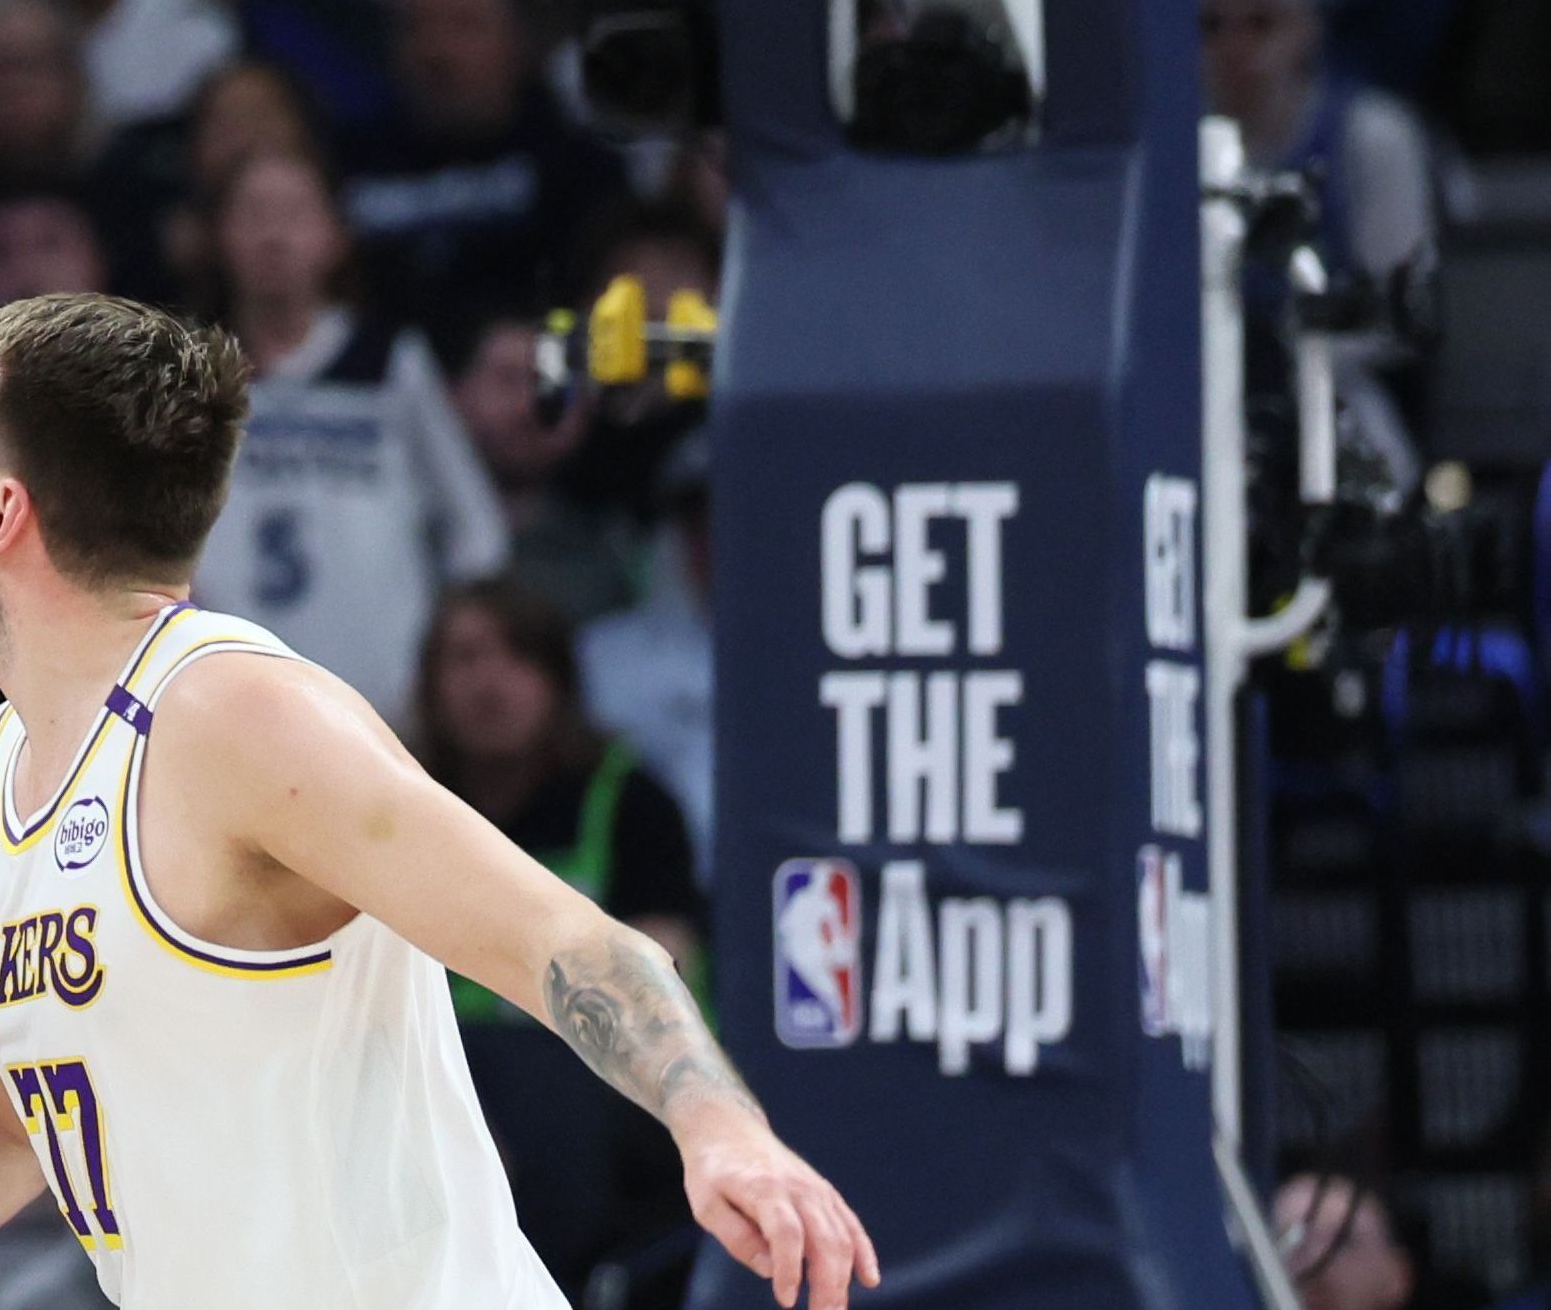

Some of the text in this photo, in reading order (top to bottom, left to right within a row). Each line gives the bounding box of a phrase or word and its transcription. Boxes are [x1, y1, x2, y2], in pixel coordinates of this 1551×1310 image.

[819, 481, 1021, 659] GET
[60, 816, 105, 846] bibigo
[818, 669, 1025, 845] THE
[867, 859, 1074, 1076] App
[6, 1056, 124, 1252] 77
